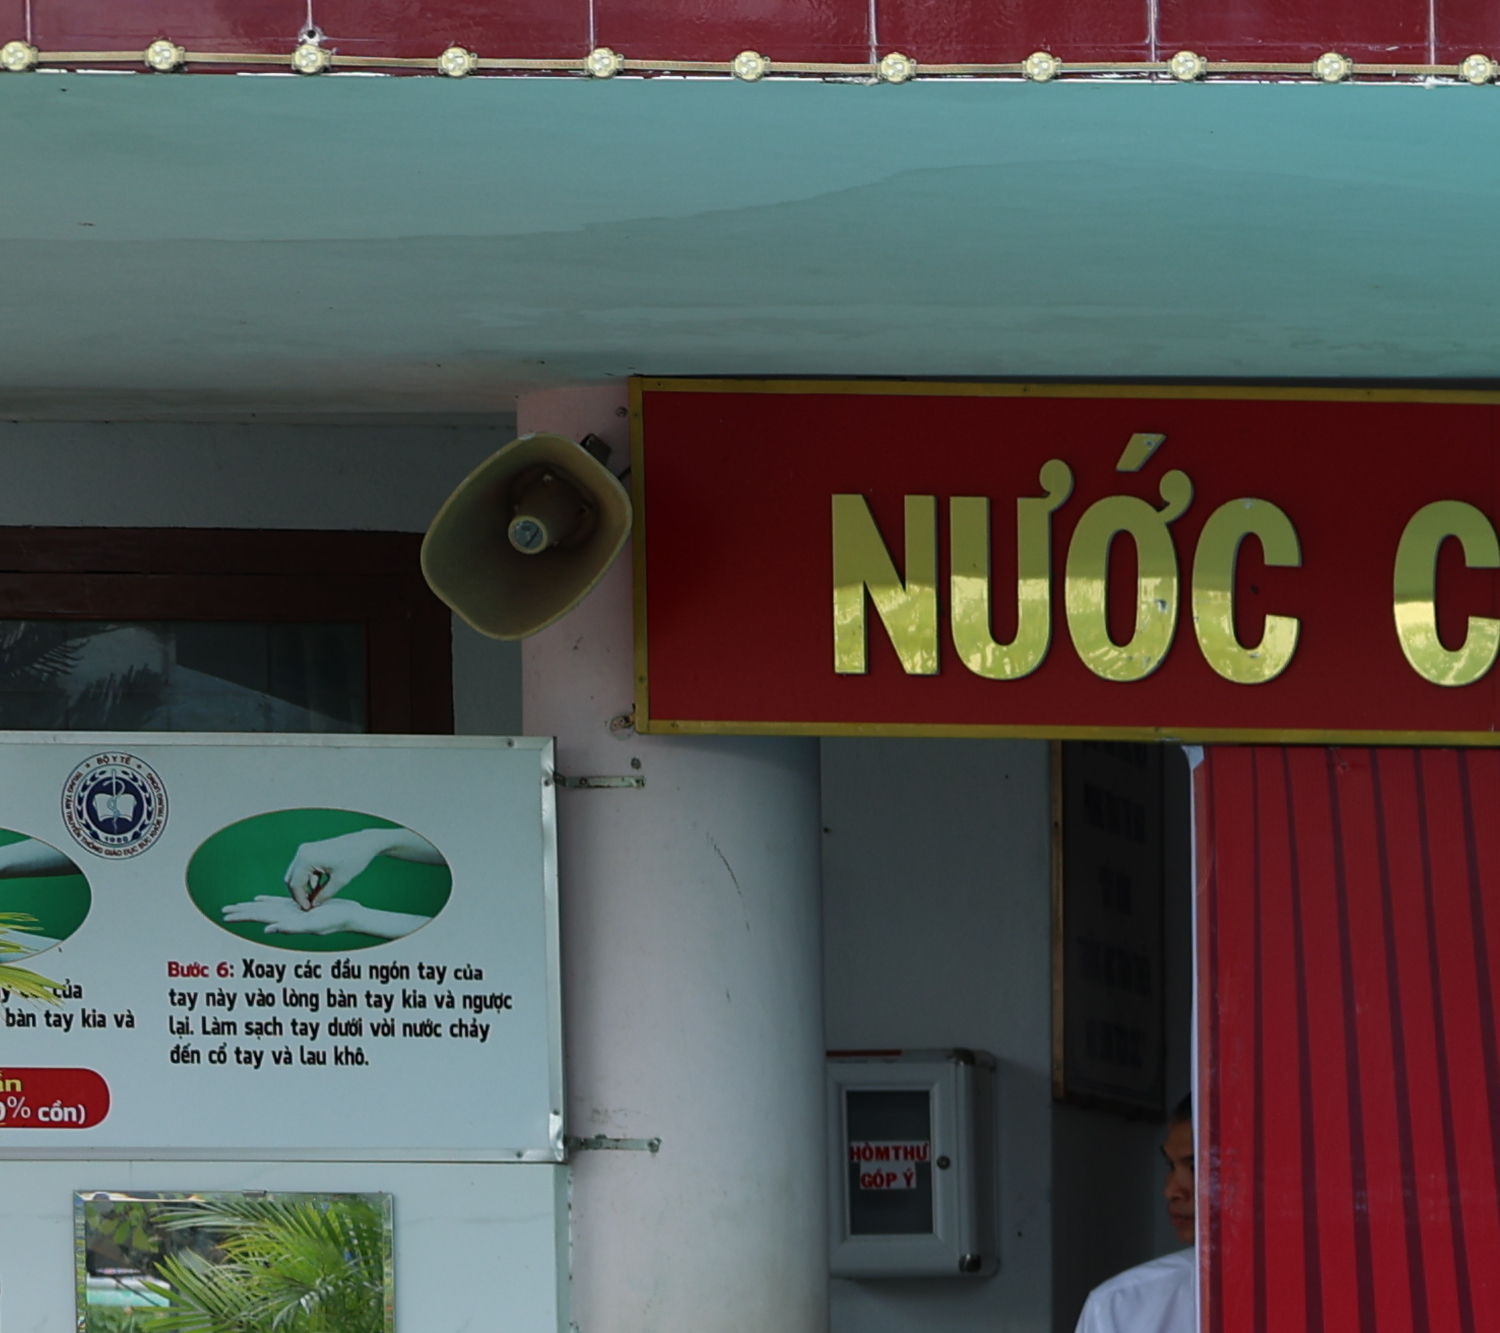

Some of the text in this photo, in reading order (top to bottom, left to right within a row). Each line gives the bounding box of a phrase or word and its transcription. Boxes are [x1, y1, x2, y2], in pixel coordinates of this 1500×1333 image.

[830, 432, 1302, 685] NƯỚC
[168, 961, 209, 977] Bước
[216, 962, 234, 977] 6:
[242, 959, 286, 983] Xoay
[294, 960, 321, 978] các
[369, 961, 409, 984] ngón
[418, 962, 446, 985] tay
[454, 964, 483, 980] của
[169, 988, 512, 1014] tay này vào lòng bàn tay kia và ngược
[6, 1008, 135, 1032] bàn tay kia và
[169, 1016, 490, 1043] lại. Làm sạch tay dưới vòi nước chảy
[170, 1042, 369, 1069] đến cổ tay và lau khô.
[38, 1100, 86, 1124] cồn)
[861, 1168, 897, 1188] GÓP
